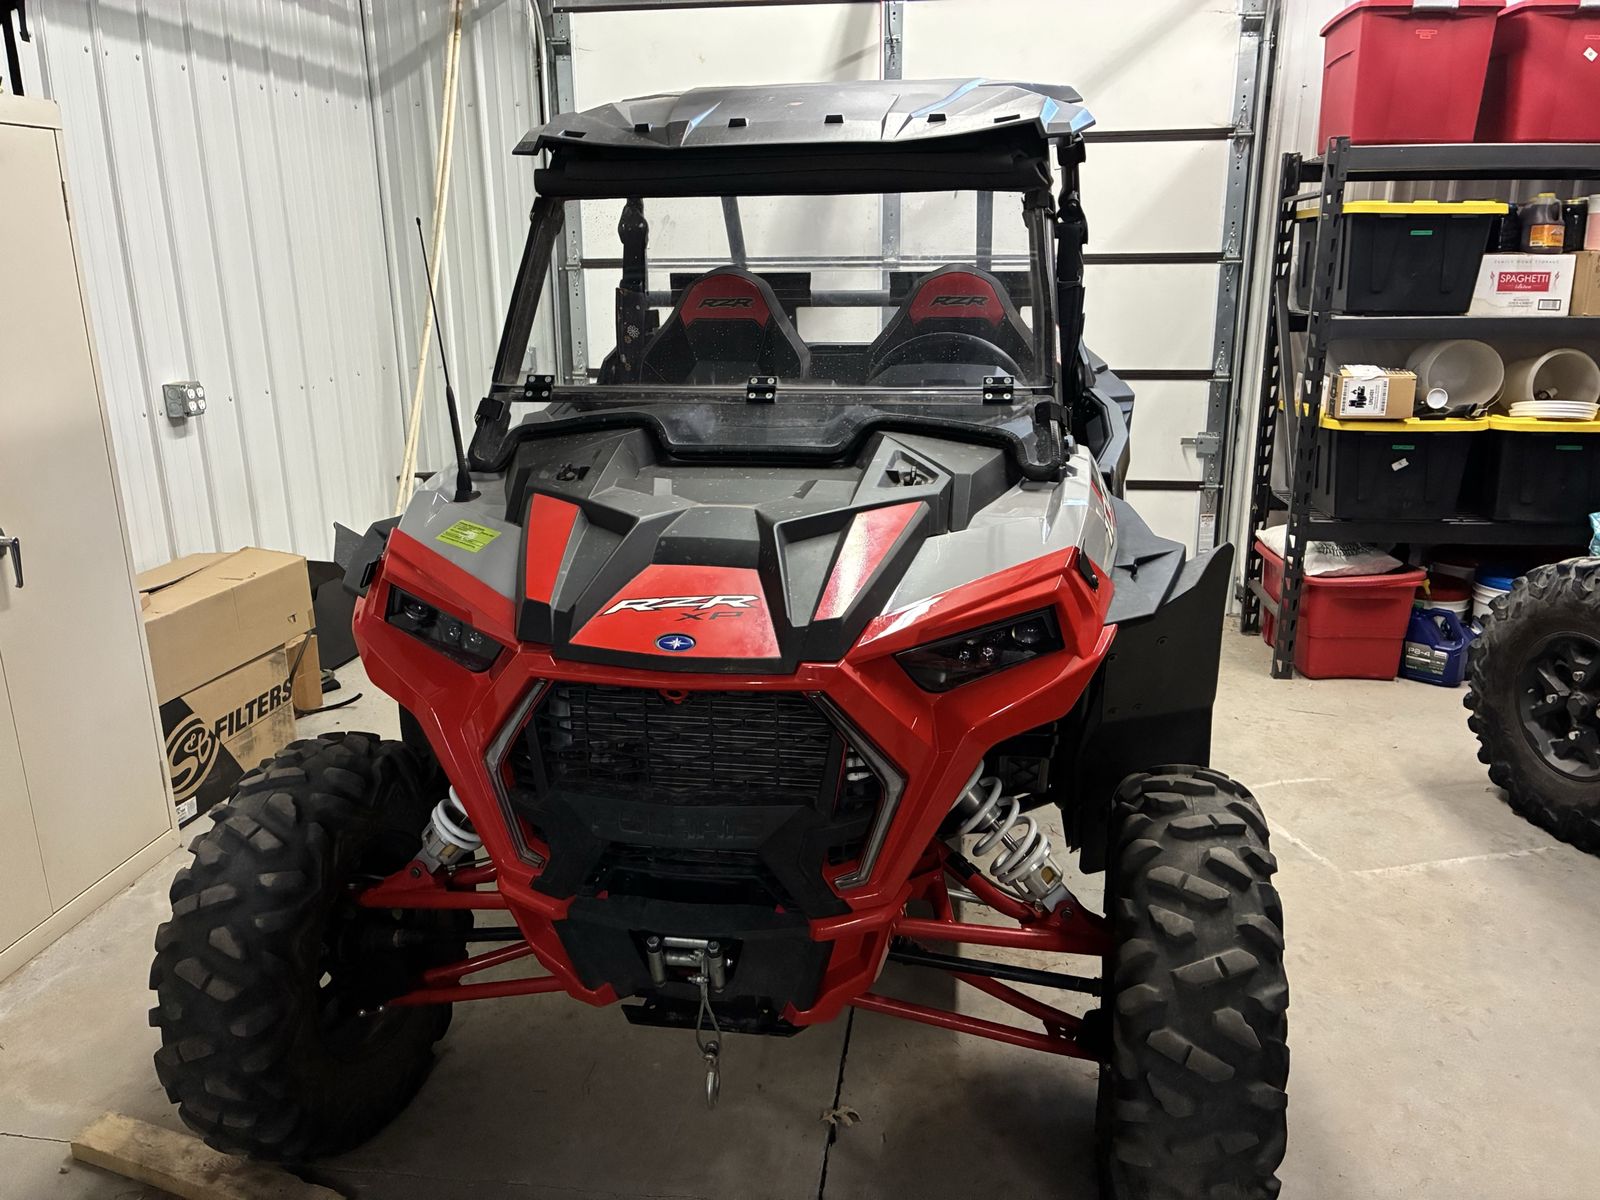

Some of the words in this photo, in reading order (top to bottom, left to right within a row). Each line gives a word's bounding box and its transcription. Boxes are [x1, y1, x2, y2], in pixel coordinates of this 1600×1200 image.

[1500, 273, 1549, 283] SPAGHETTI
[696, 297, 754, 310] RZR
[928, 295, 989, 308] RZR
[599, 595, 760, 617] RZR
[674, 612, 743, 622] XP
[215, 678, 292, 741] FILTERS
